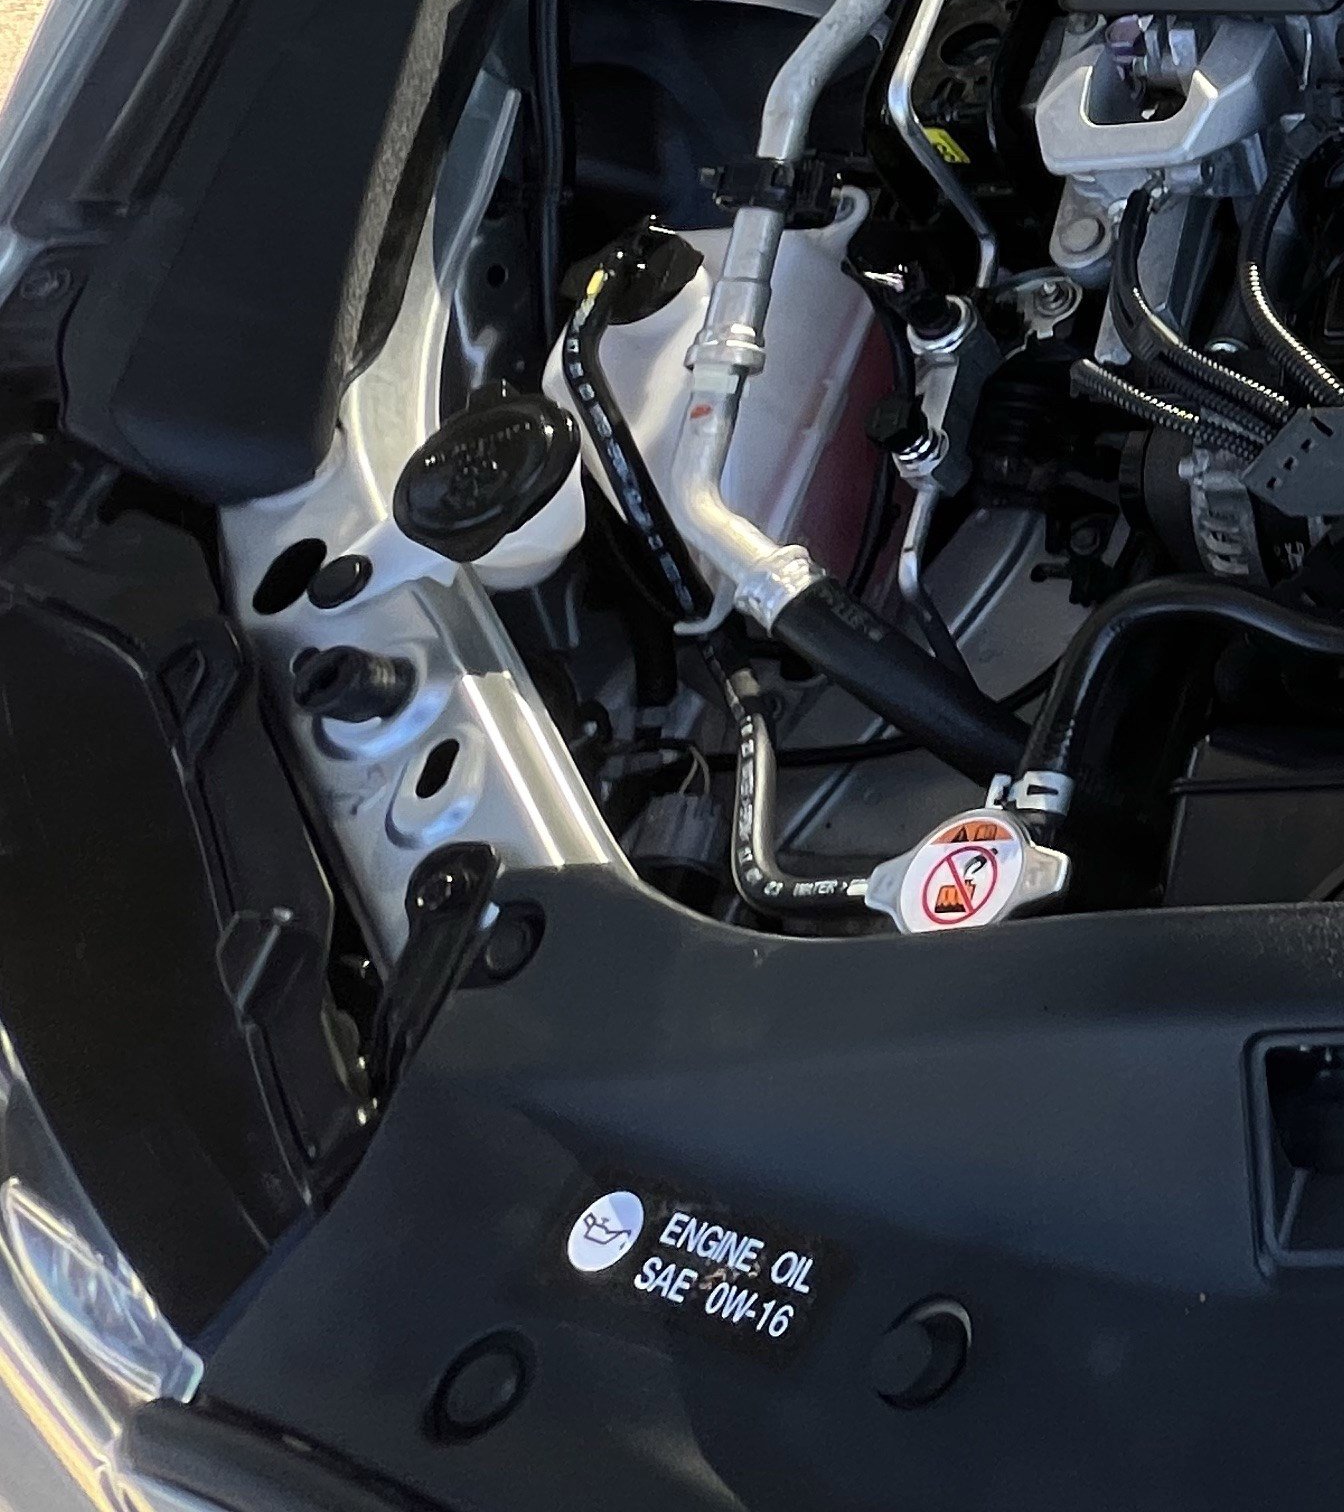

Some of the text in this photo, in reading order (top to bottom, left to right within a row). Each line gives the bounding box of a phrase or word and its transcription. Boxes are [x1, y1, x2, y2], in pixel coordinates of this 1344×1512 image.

[659, 1211, 814, 1294] ENGINE OIL
[633, 1256, 795, 1338] SAE 0W-16
